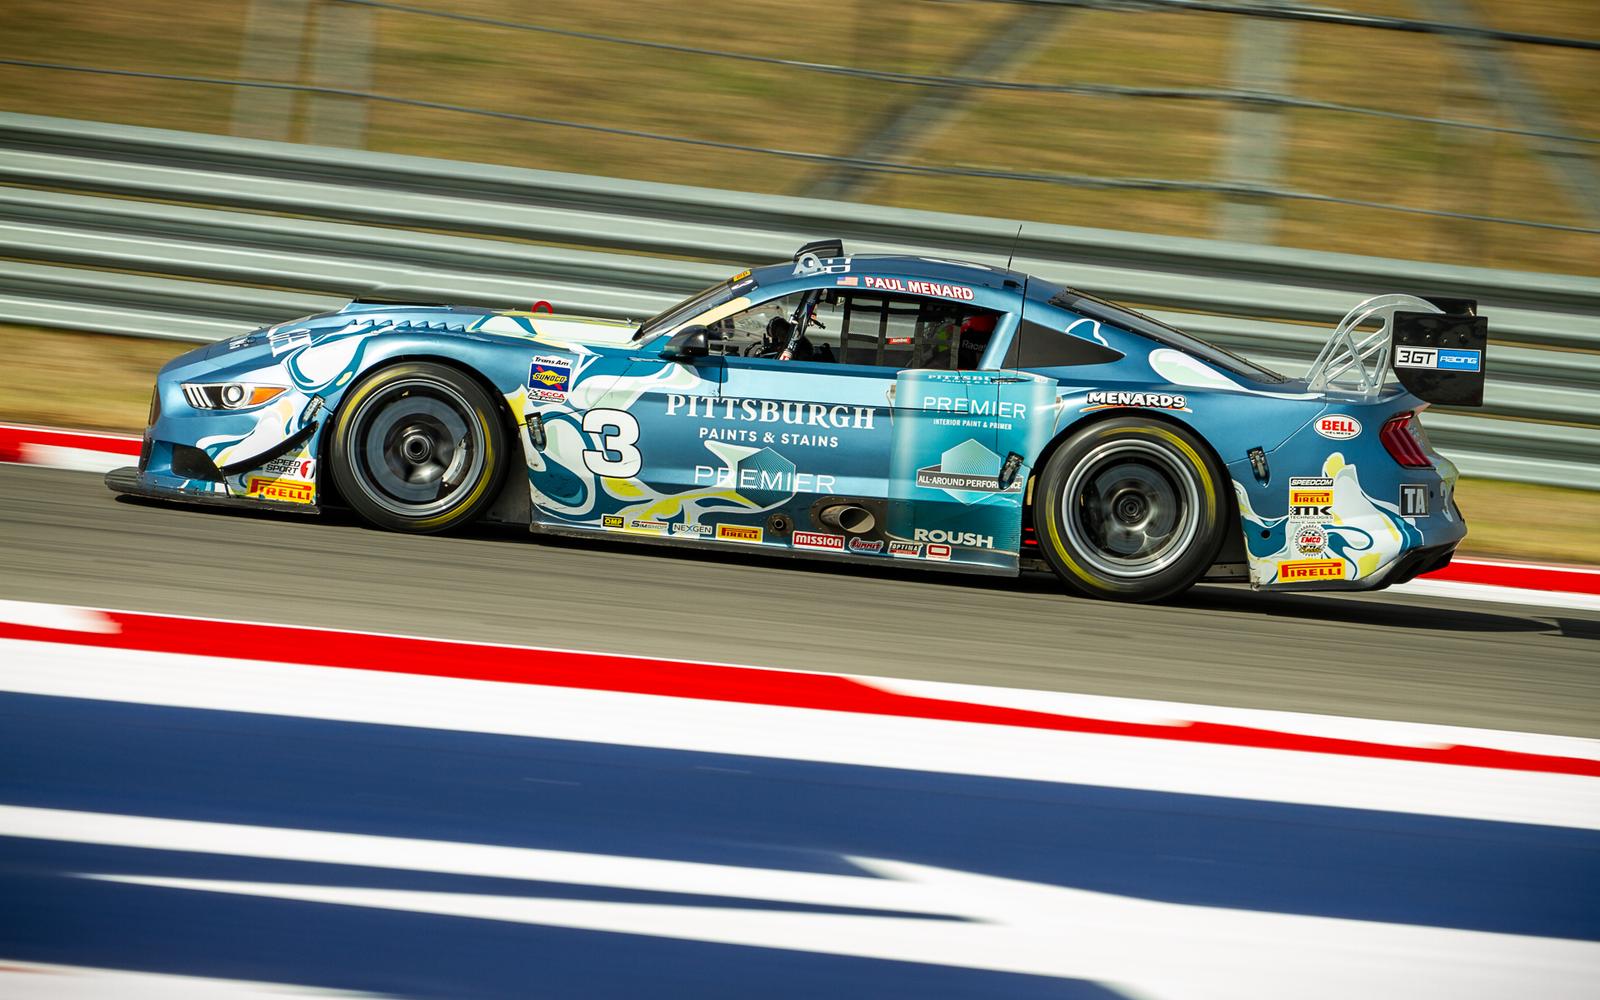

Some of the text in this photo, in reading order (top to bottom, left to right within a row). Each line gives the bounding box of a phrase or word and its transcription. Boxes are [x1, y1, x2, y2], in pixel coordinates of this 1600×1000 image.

[864, 276, 974, 300] PAUL MENARD
[1398, 350, 1436, 364] 3GT
[534, 373, 566, 383] SUNOCO
[540, 391, 565, 399] SCCA
[1087, 391, 1186, 408] MENARDS
[665, 394, 876, 430] PITTSBURGH
[923, 396, 1027, 419] PREMIER
[933, 418, 960, 426] INTERIOR
[962, 419, 981, 428] PAINT
[989, 422, 1012, 430] PRIMER
[1322, 420, 1355, 432] BELL
[581, 407, 643, 479] 3
[699, 427, 839, 448] PAINTS & STAINS
[266, 464, 299, 474] SPORT
[271, 459, 301, 468] SPEED
[694, 465, 836, 493] PREMIER
[918, 475, 964, 487] ALL-AROUND
[1294, 493, 1330, 502] PIRELLI
[1404, 488, 1426, 514] TA
[604, 518, 623, 526] OMP
[673, 524, 711, 533] NEXGEN
[722, 527, 758, 539] PIRELLI
[914, 528, 994, 549] ROUSH
[892, 543, 918, 551] OPTIMA
[1282, 562, 1342, 577] PIRELLI
